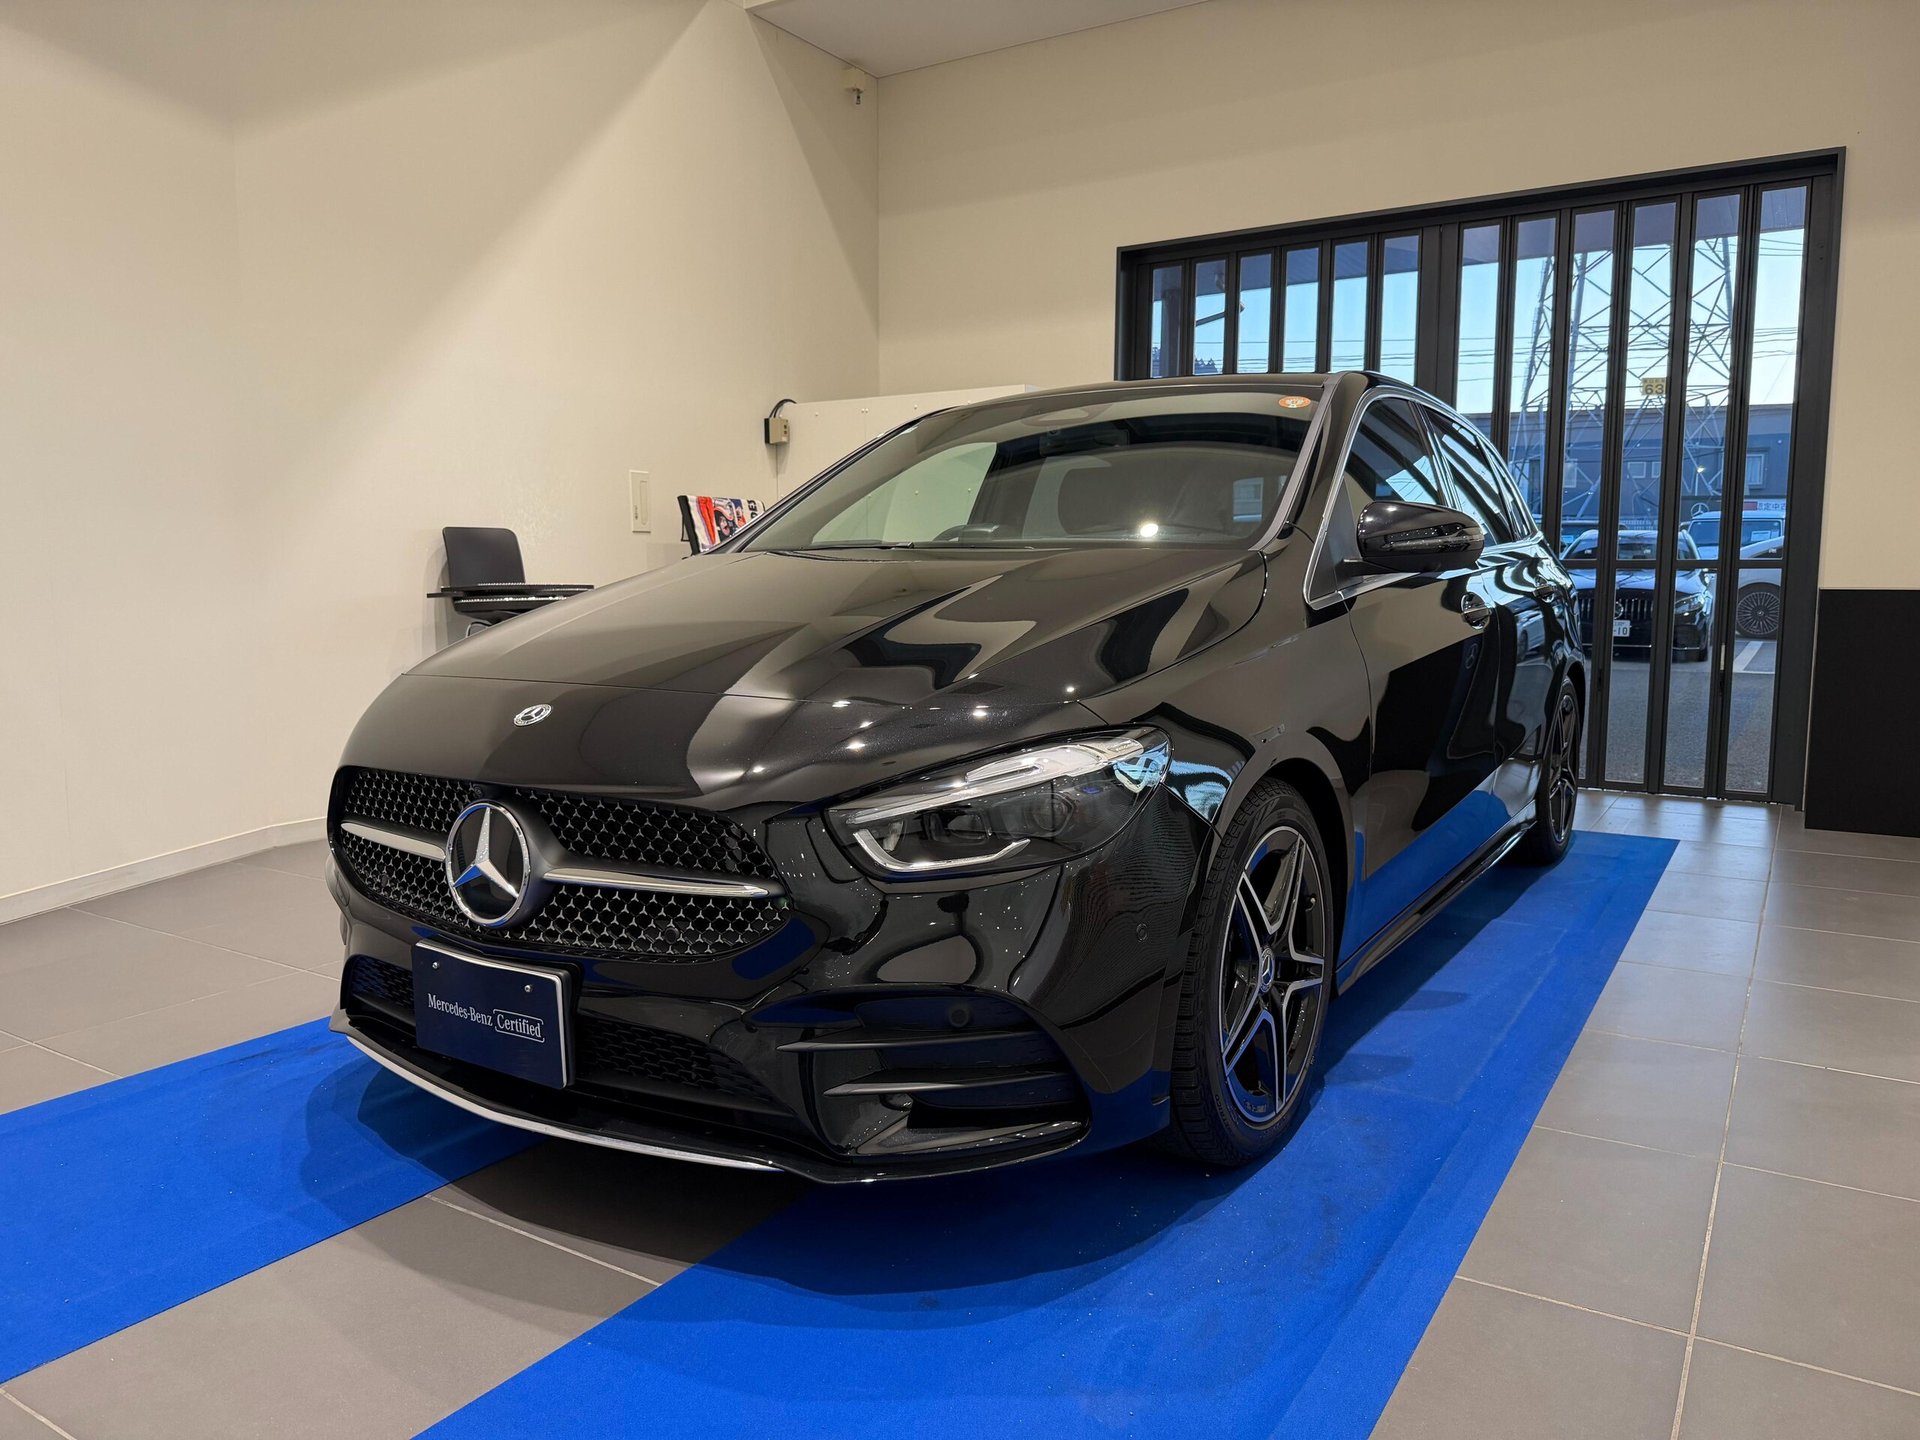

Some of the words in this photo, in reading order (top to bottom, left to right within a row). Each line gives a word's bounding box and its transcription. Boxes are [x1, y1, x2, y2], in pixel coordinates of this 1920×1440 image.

[1645, 384, 1664, 395] 63
[427, 993, 493, 1027] Mercedes-Benz
[497, 1014, 542, 1038] Certified
